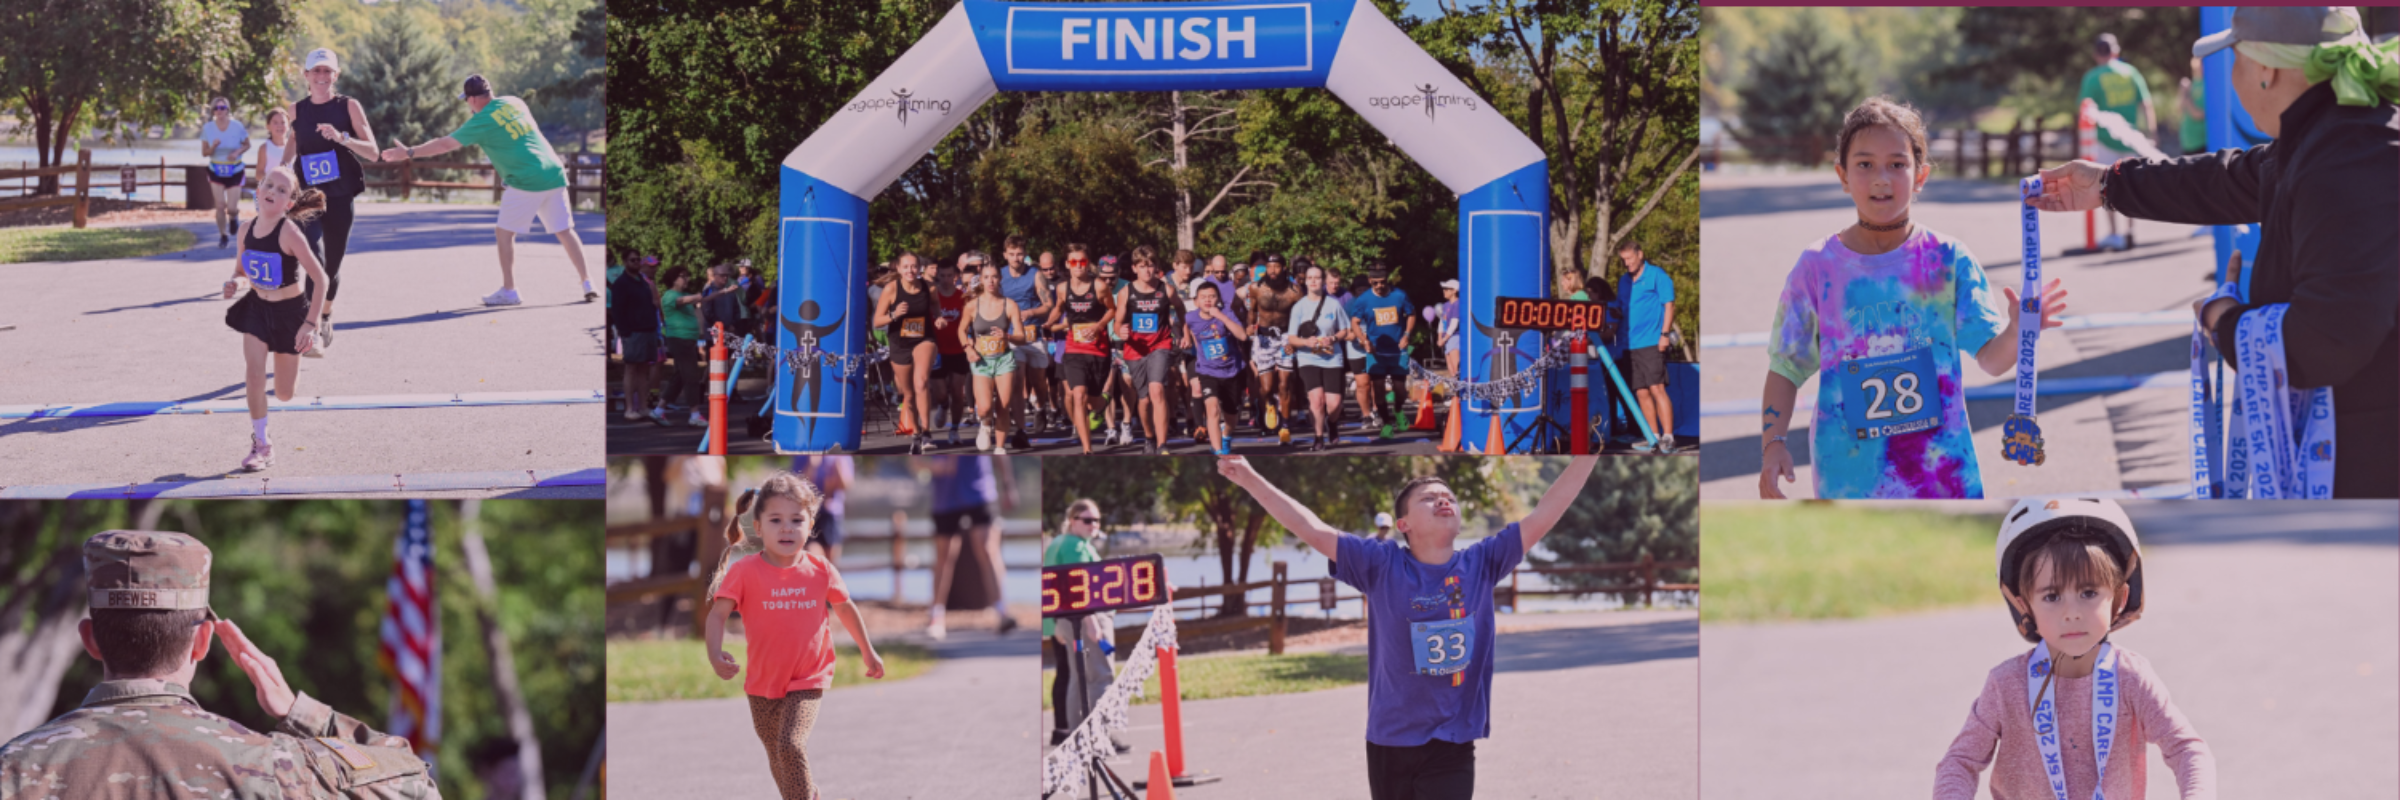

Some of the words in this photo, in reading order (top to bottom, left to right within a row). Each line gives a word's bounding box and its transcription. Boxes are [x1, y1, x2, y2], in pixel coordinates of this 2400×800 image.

[1062, 16, 1256, 61] FINISH
[309, 159, 331, 178] 50
[249, 260, 273, 283] 51
[2025, 236, 2039, 281] CAMP
[1137, 318, 1154, 330] 19
[2239, 316, 2252, 369] CAMP
[1208, 343, 1226, 358] 33
[2021, 329, 2036, 367] 2025
[2254, 336, 2269, 392] CAMP
[1861, 371, 1924, 420] 28
[2019, 369, 2034, 390] 5K
[2193, 378, 2205, 429] CAMP
[2244, 373, 2262, 426] CARE
[2194, 433, 2210, 481] CARE
[2230, 436, 2248, 482] 2025
[2251, 430, 2267, 456] 5K
[2256, 461, 2277, 499] 202
[108, 591, 158, 607] BREWER
[761, 599, 817, 610] TOGETHER
[771, 586, 807, 598] HAPPY
[1426, 632, 1467, 664] 33
[2096, 661, 2115, 708] AMP
[2036, 699, 2056, 747] 2025
[2096, 713, 2114, 763] CARE
[2045, 752, 2061, 776] 5K
